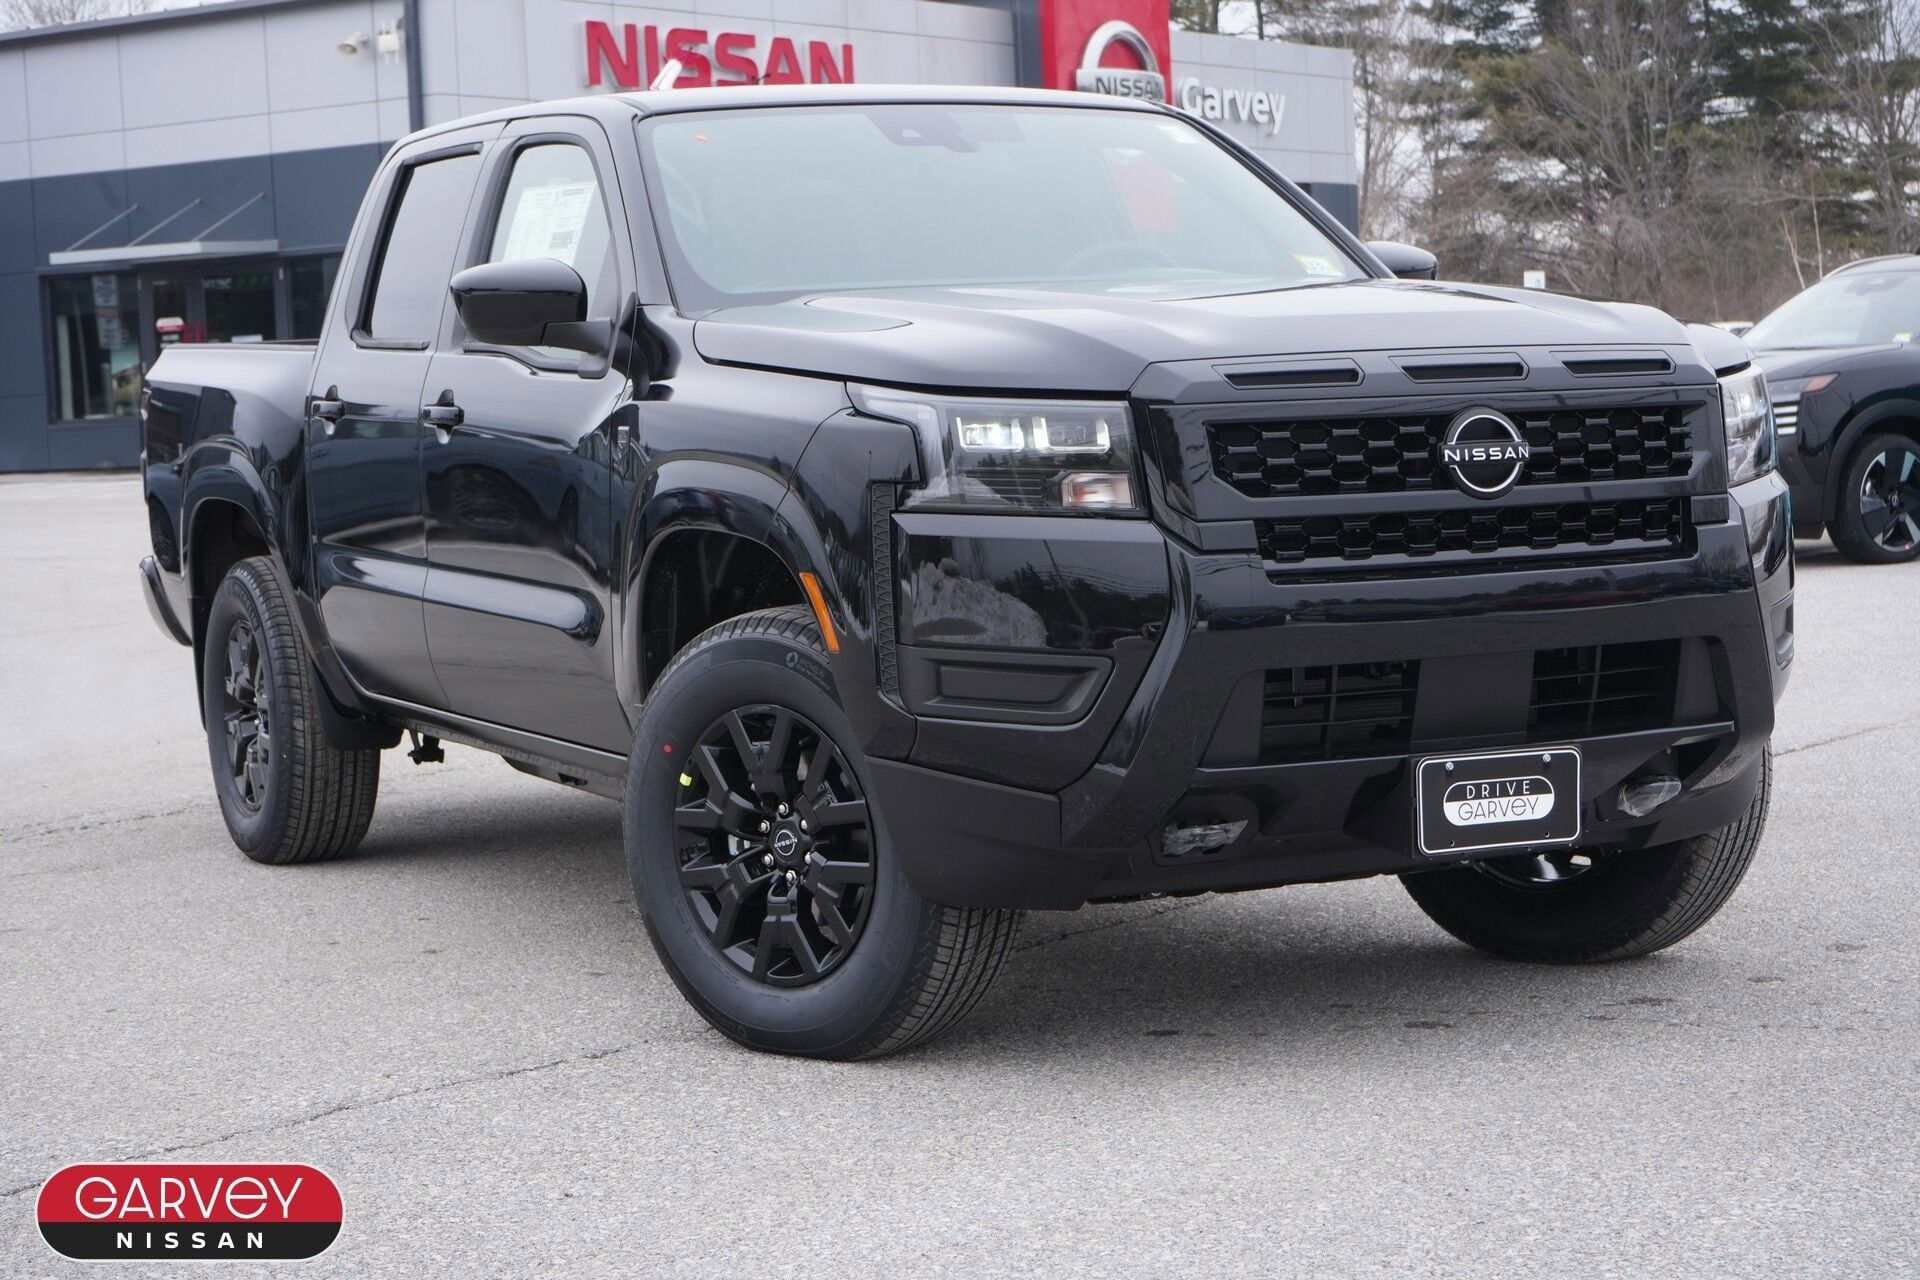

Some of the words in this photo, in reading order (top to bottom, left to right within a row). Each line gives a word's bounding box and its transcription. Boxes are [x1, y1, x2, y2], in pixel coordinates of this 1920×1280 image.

[586, 20, 854, 89] NISSAN
[1095, 76, 1164, 100] NISSAN
[1180, 77, 1287, 136] Garvey
[1444, 445, 1529, 462] NISSAN
[1466, 780, 1530, 799] DRIVE
